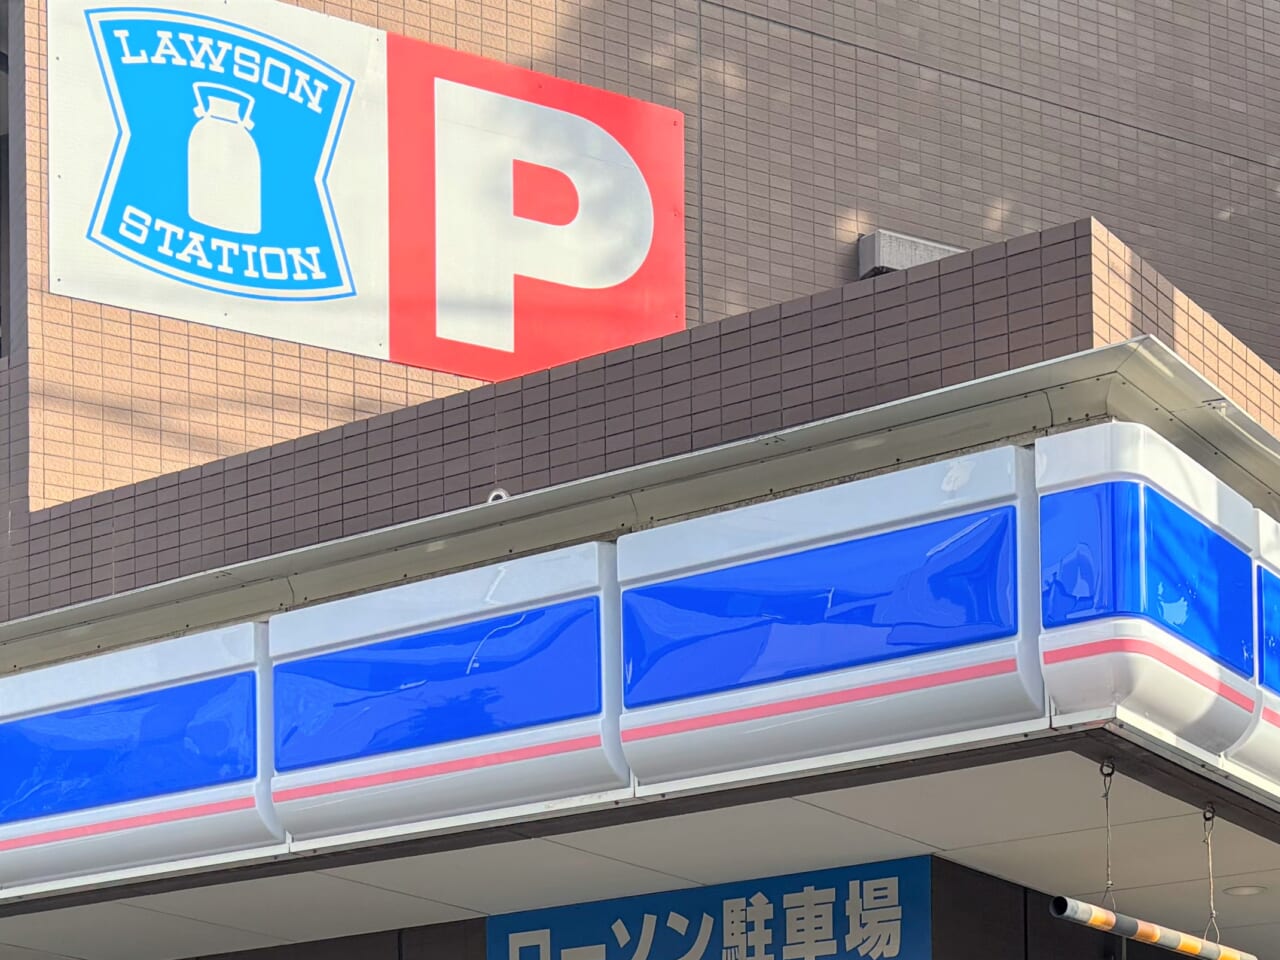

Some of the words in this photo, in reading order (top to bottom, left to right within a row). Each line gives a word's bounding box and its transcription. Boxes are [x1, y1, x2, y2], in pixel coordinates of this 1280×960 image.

[113, 29, 328, 114] LAWSON
[118, 205, 327, 281] STATION
[434, 77, 654, 353] P
